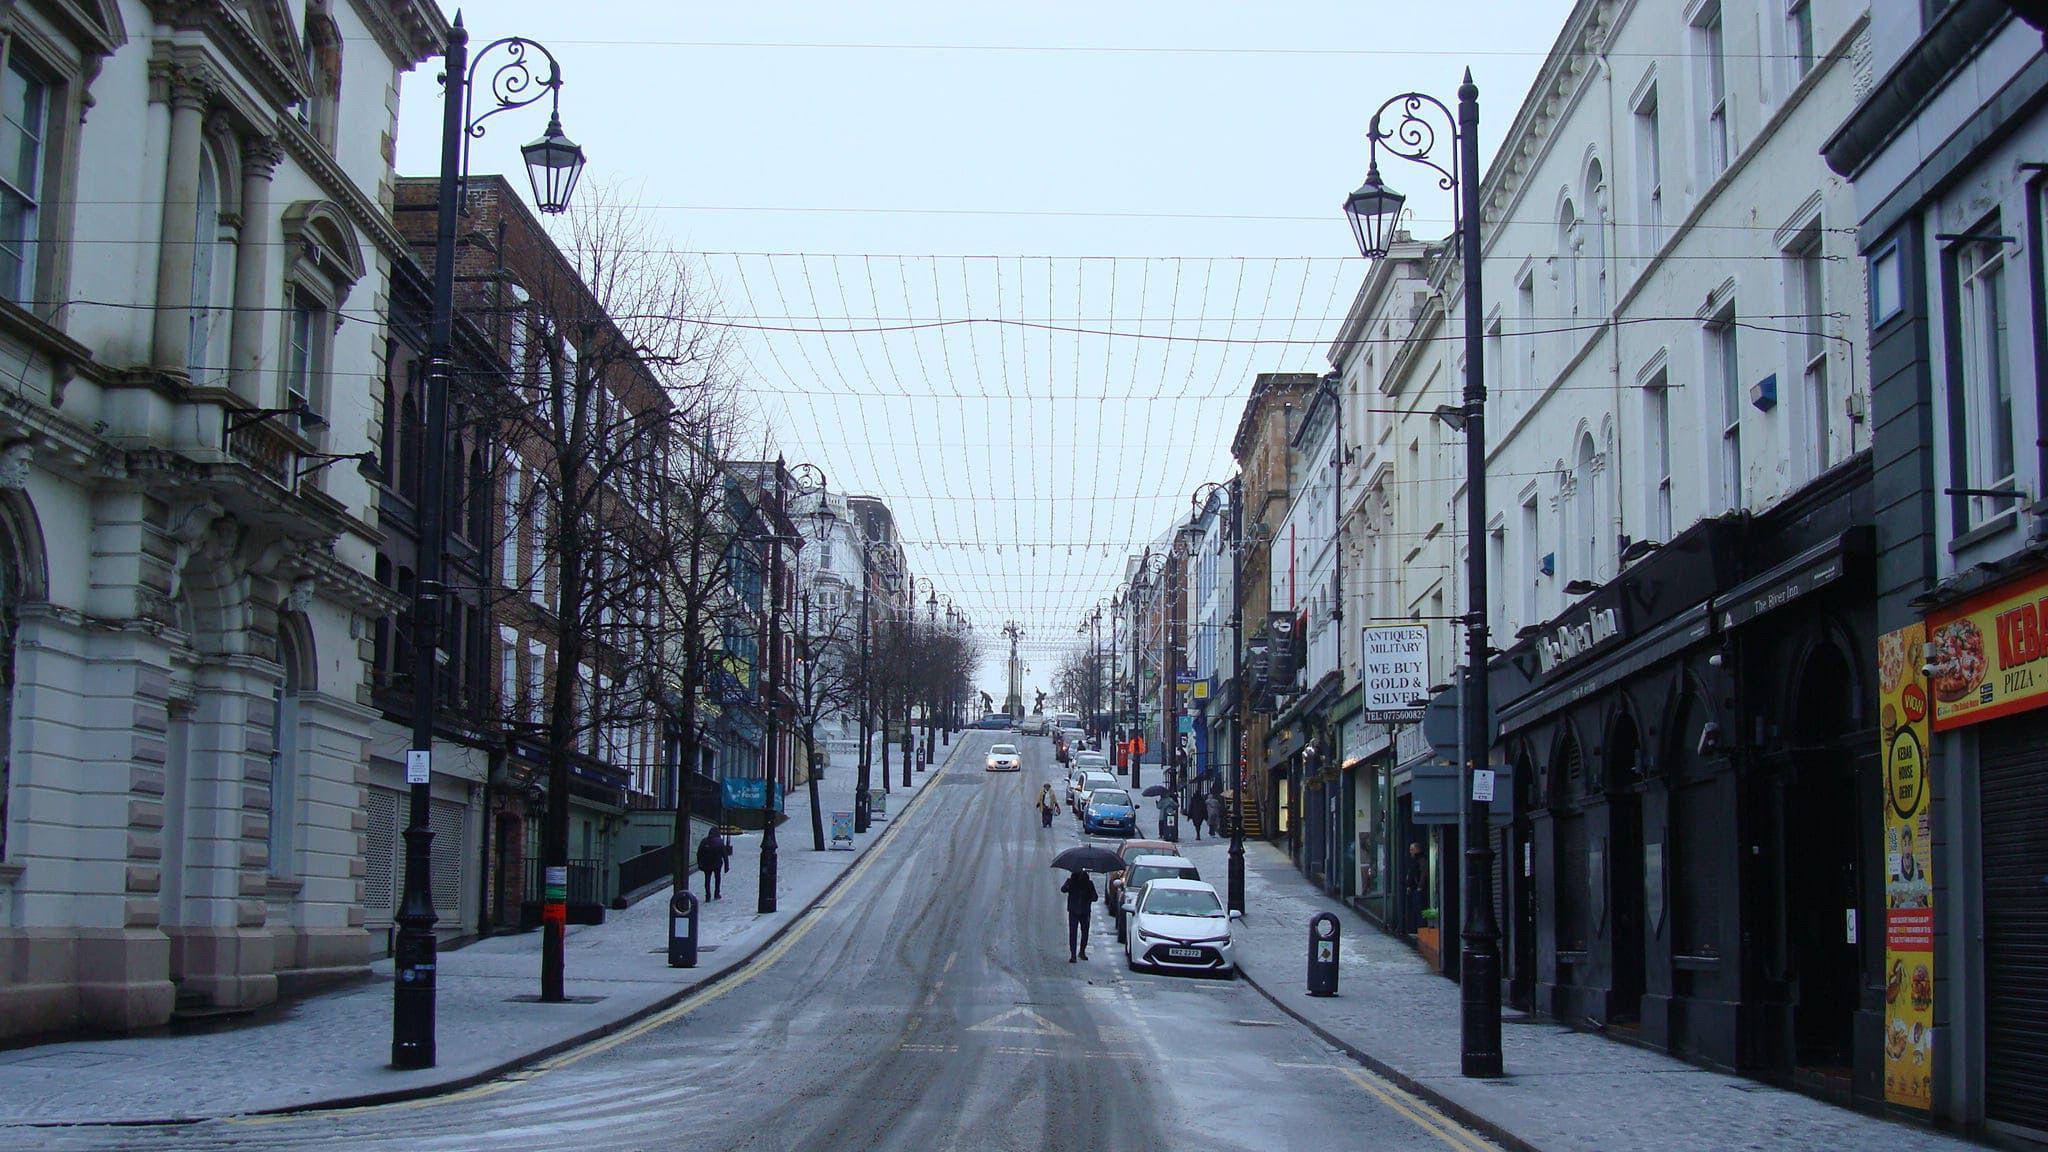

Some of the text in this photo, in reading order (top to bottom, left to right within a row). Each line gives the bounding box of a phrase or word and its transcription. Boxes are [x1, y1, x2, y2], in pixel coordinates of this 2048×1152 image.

[1754, 584, 1799, 613] The River Inn
[1370, 642, 1421, 654] MILITARY
[1535, 606, 1618, 674] The River Inn
[1369, 661, 1422, 674] WE BUY
[1370, 677, 1422, 689] GOLD &
[2004, 669, 2034, 694] PIZZA
[1372, 692, 1420, 705] SILVER
[1904, 694, 1924, 714] WOW
[1366, 711, 1383, 721] TEL:
[1897, 745, 1913, 761] KEBAB
[1898, 764, 1913, 781] HOUSE
[1898, 783, 1913, 800] DERRY
